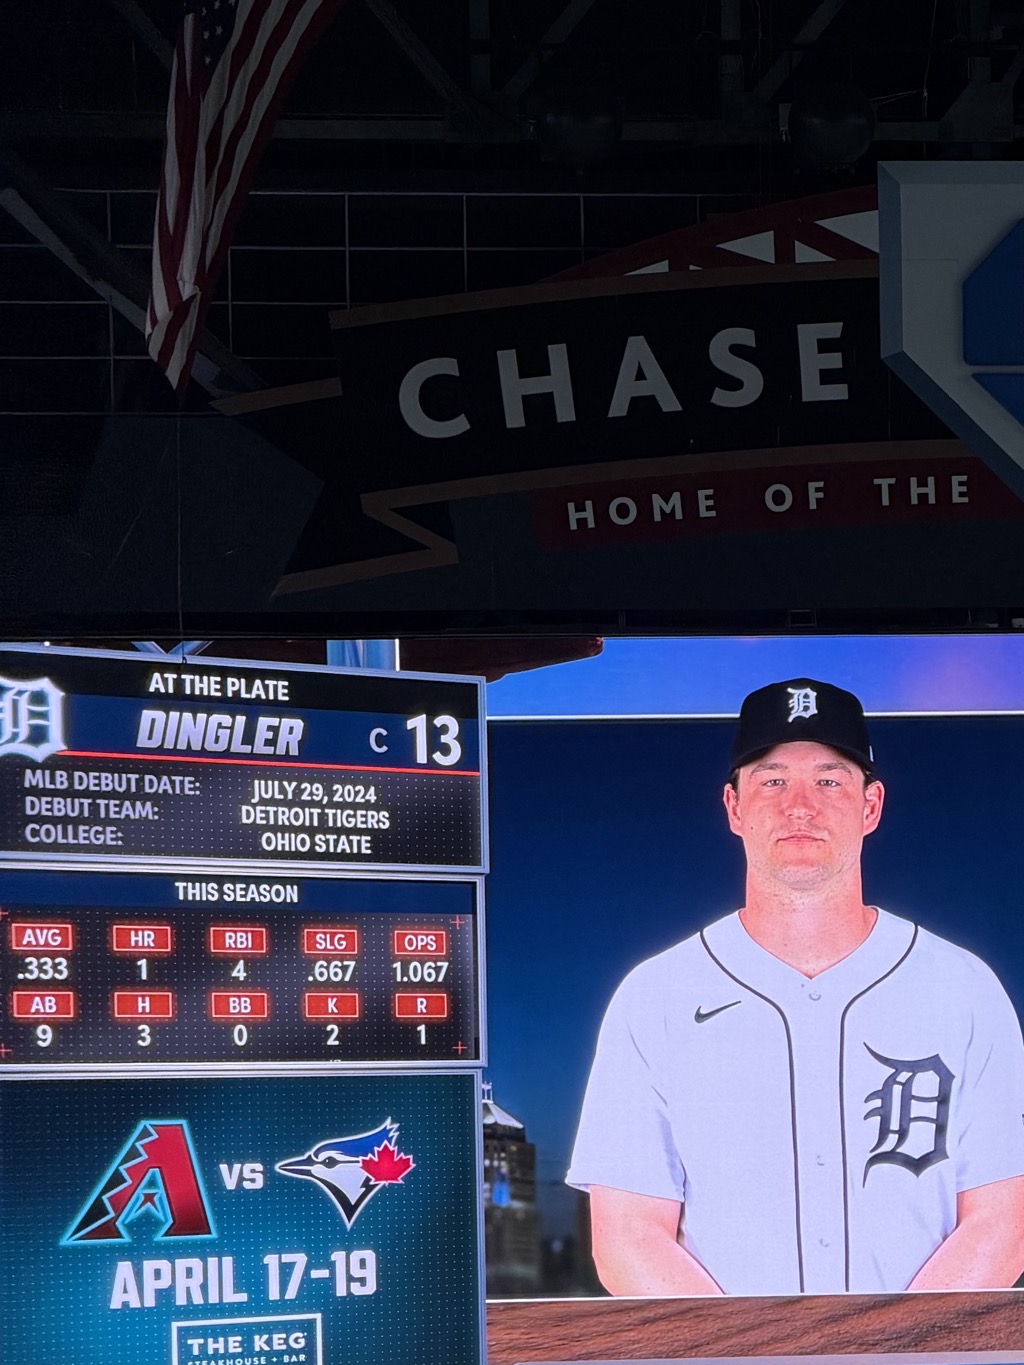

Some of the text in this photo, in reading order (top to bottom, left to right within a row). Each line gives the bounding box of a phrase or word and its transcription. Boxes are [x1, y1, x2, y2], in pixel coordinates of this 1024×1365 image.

[398, 321, 849, 439] CHASE
[567, 488, 717, 531] HOME
[764, 481, 825, 513] OF
[873, 475, 969, 507] THE
[148, 672, 290, 701] AT THE PLATE
[136, 709, 462, 766] DINGLER C 13
[23, 768, 377, 805] MLB DEBUT DATE: JULY 29, 2024
[25, 795, 390, 830] DEBUT TEAM: DETROIT TIGERS
[24, 823, 372, 854] COLLEGE: OHIO STATE
[174, 881, 298, 903] THIS SEASON
[22, 928, 437, 951] AVG HR RBI SLG OPS
[17, 956, 449, 983] .333 .667 1.067
[30, 996, 252, 1014] AB BB
[218, 1162, 264, 1190] VS
[109, 1249, 377, 1310] APRIL 17-19
[187, 1332, 306, 1356] THE KEG
[283, 1353, 306, 1363] BAR
